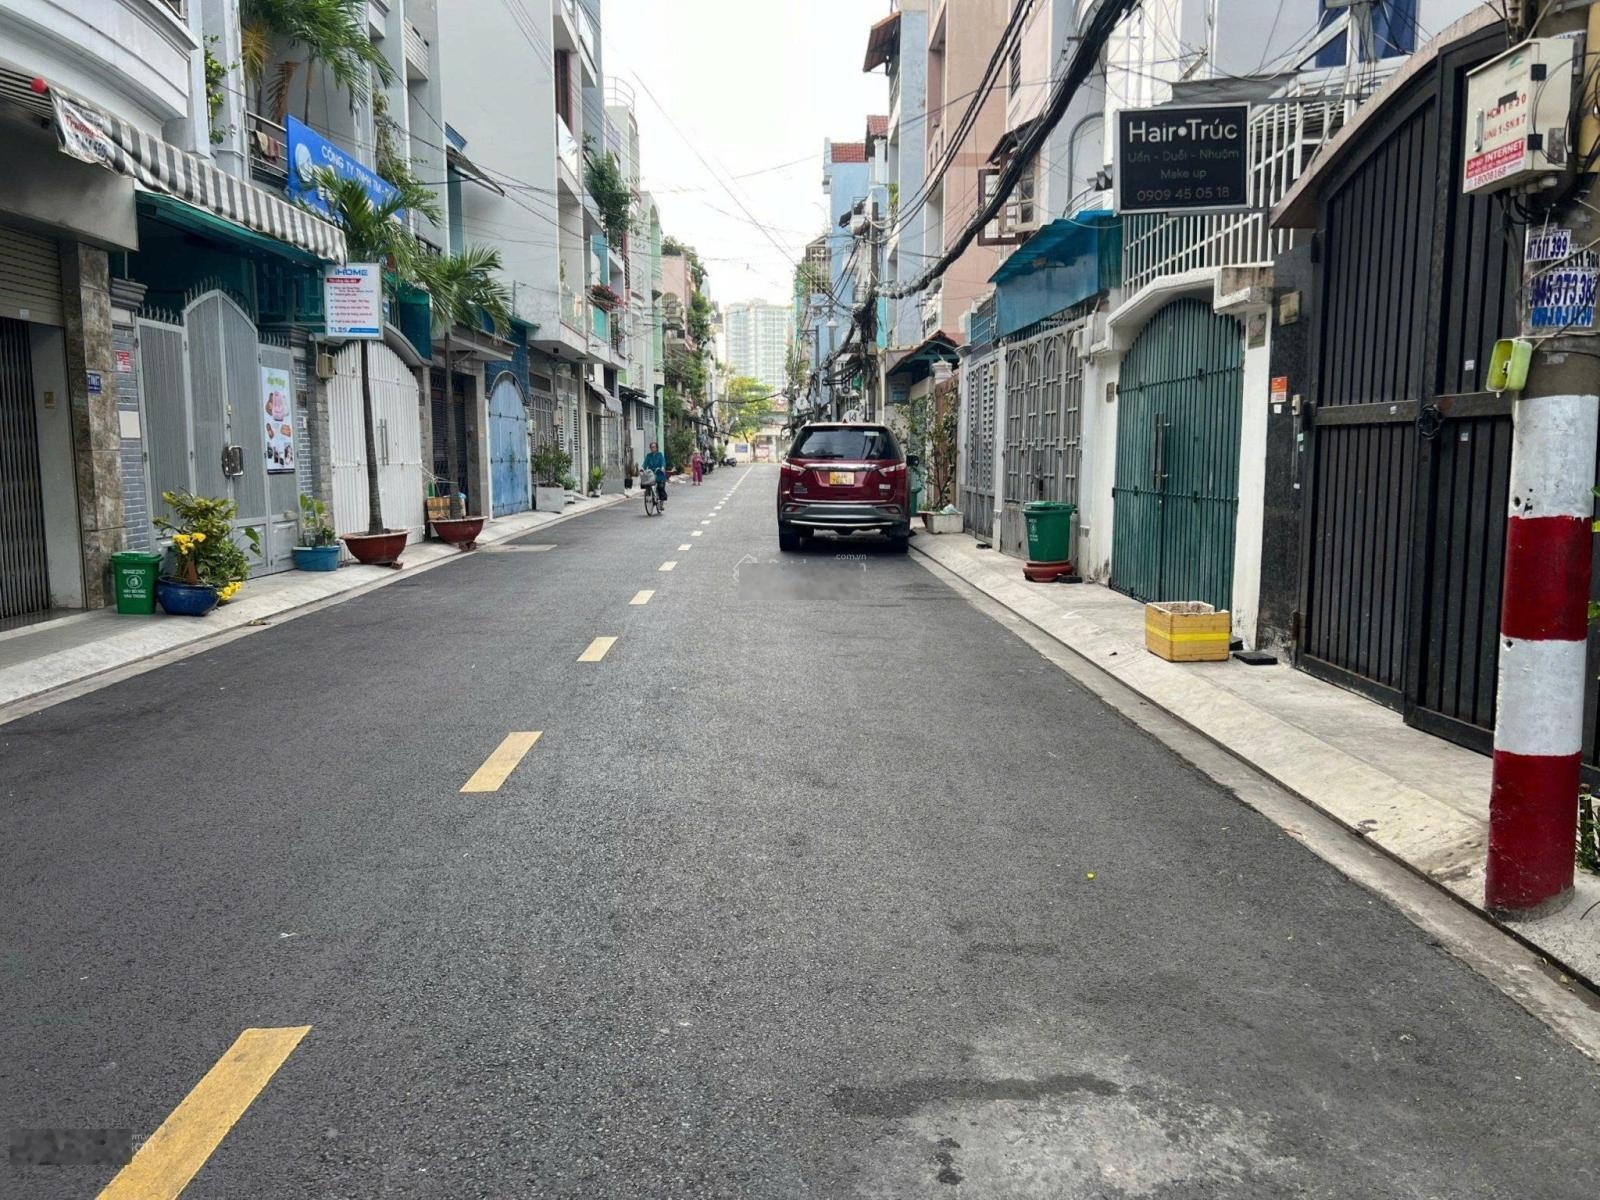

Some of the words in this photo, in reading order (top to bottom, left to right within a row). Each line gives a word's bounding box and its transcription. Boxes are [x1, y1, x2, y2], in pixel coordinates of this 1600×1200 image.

[1129, 121, 1177, 143] Hair
[1186, 118, 1237, 141] Trúc
[321, 145, 344, 169] CÔNG
[346, 161, 355, 176] TY
[1485, 140, 1522, 163] INTERNET
[1160, 168, 1189, 179] Make
[1193, 170, 1207, 180] up
[1137, 189, 1171, 201] 0909
[1175, 187, 1192, 200] 45
[1195, 186, 1213, 199] 05
[1217, 186, 1230, 198] 18
